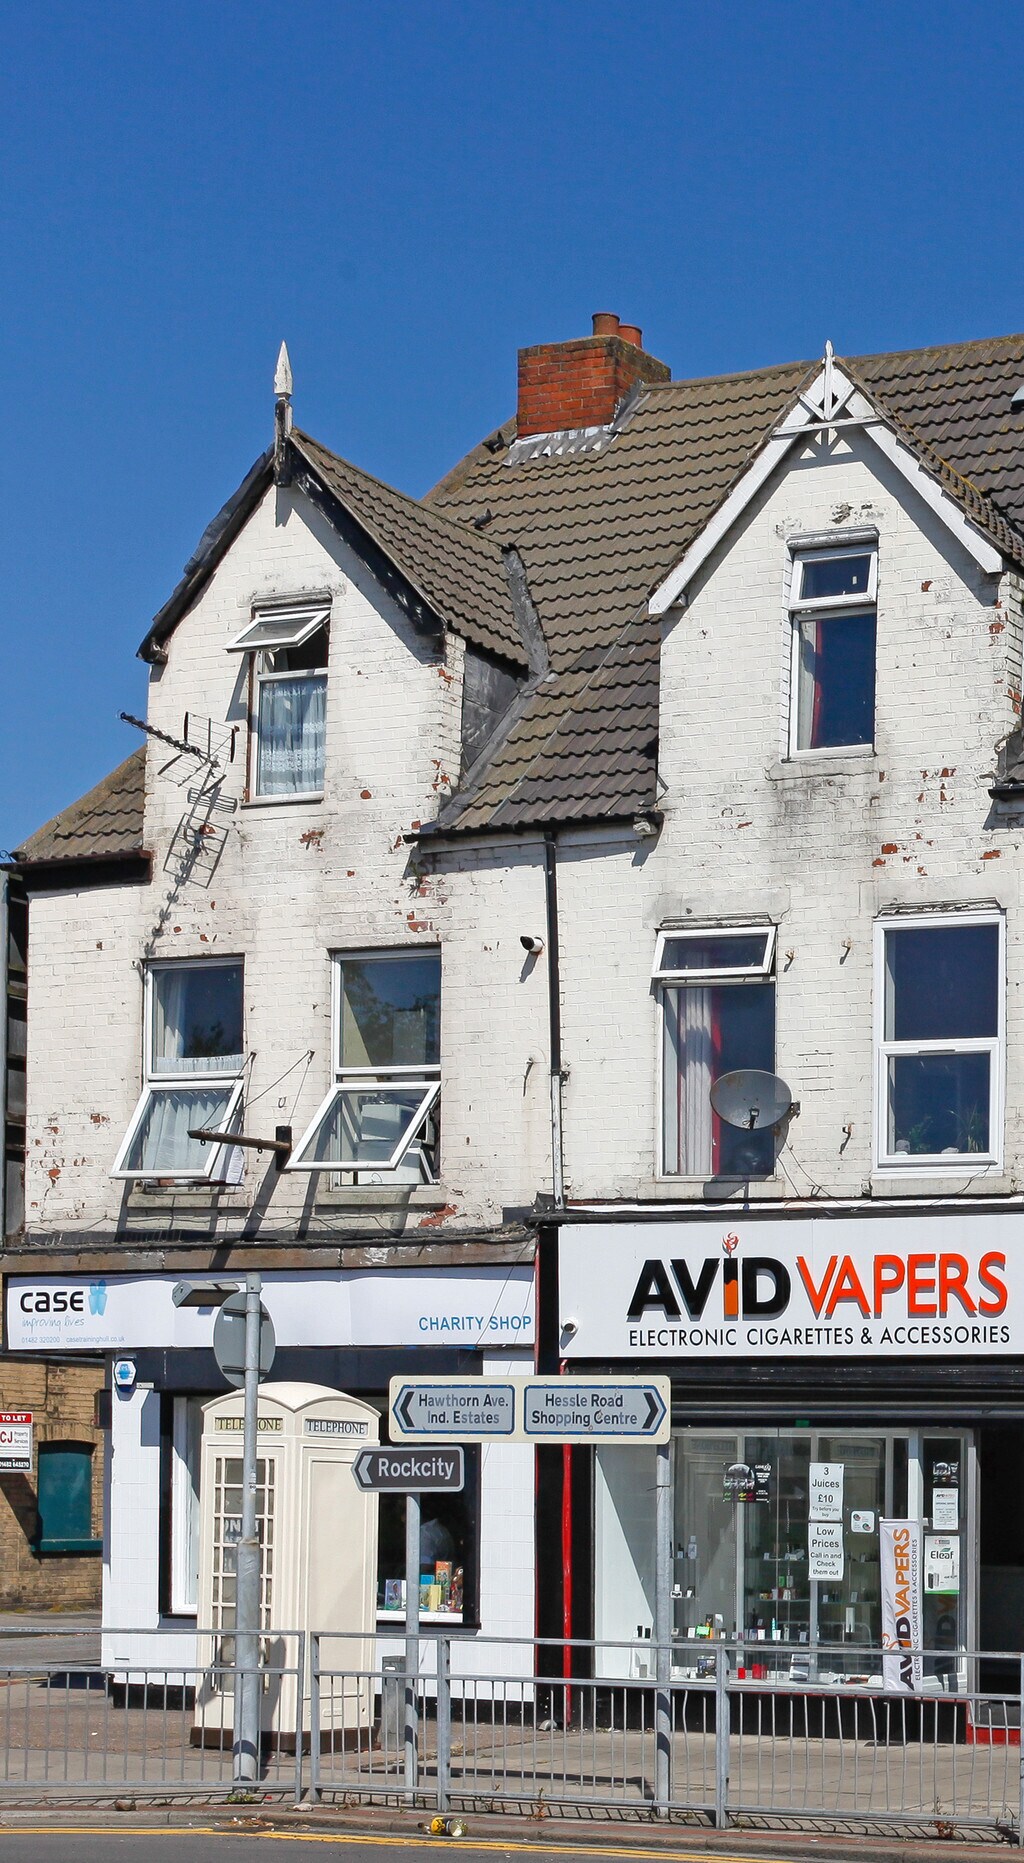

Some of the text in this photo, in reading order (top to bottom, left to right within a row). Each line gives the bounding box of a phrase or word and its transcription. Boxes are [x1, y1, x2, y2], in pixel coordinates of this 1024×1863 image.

[626, 1251, 1008, 1321] AVID VAPERS
[20, 1291, 84, 1313] case
[22, 1315, 85, 1333] improving lives
[419, 1315, 531, 1330] CHARITY SHOP
[629, 1326, 1010, 1346] ELECTRONIC CIGARETTES & ACCESSORIES
[418, 1393, 509, 1407] Hawthorn Ave.
[545, 1393, 623, 1408] Hessle Road
[427, 1411, 500, 1424] Ind. Estates
[531, 1411, 638, 1427] Shopping Centre
[218, 1419, 282, 1431] TELEONE
[307, 1420, 365, 1434] TELEPHONE
[0, 1431, 12, 1443] CJ
[378, 1457, 455, 1480] Rockcity
[823, 1466, 829, 1476] 3
[812, 1478, 840, 1488] Juices
[818, 1494, 834, 1503] £10
[816, 1526, 835, 1536] Low
[811, 1539, 840, 1548] Prices
[810, 1551, 823, 1559] Call
[930, 1550, 954, 1560] Eleaf
[816, 1560, 836, 1568] Check
[893, 1527, 915, 1691] AVID VAPERS
[911, 1595, 919, 1637] CIGARETTES
[912, 1638, 921, 1681] ELECTRNIC
